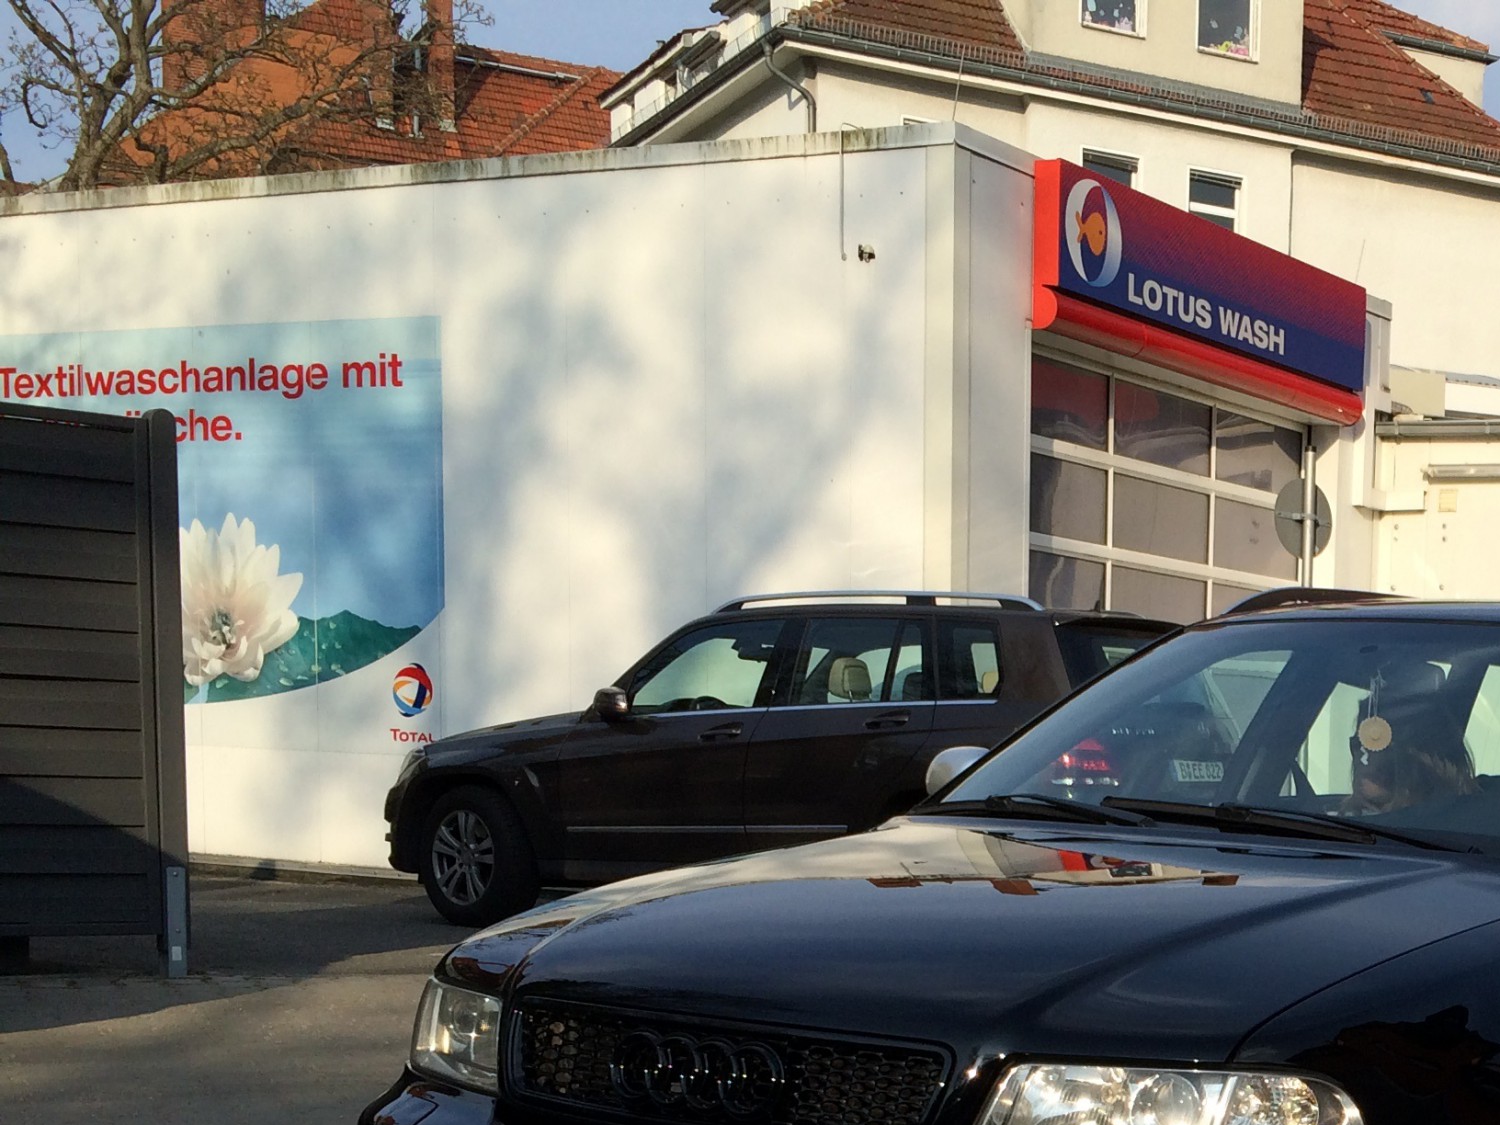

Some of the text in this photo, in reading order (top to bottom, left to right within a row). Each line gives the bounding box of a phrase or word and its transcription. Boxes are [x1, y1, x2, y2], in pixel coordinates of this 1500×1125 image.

[1128, 272, 1285, 356] LOTUS WASH
[0, 353, 403, 400] Textilwaschanlage mit
[390, 728, 437, 743] TOTAL
[1178, 762, 1187, 780] B
